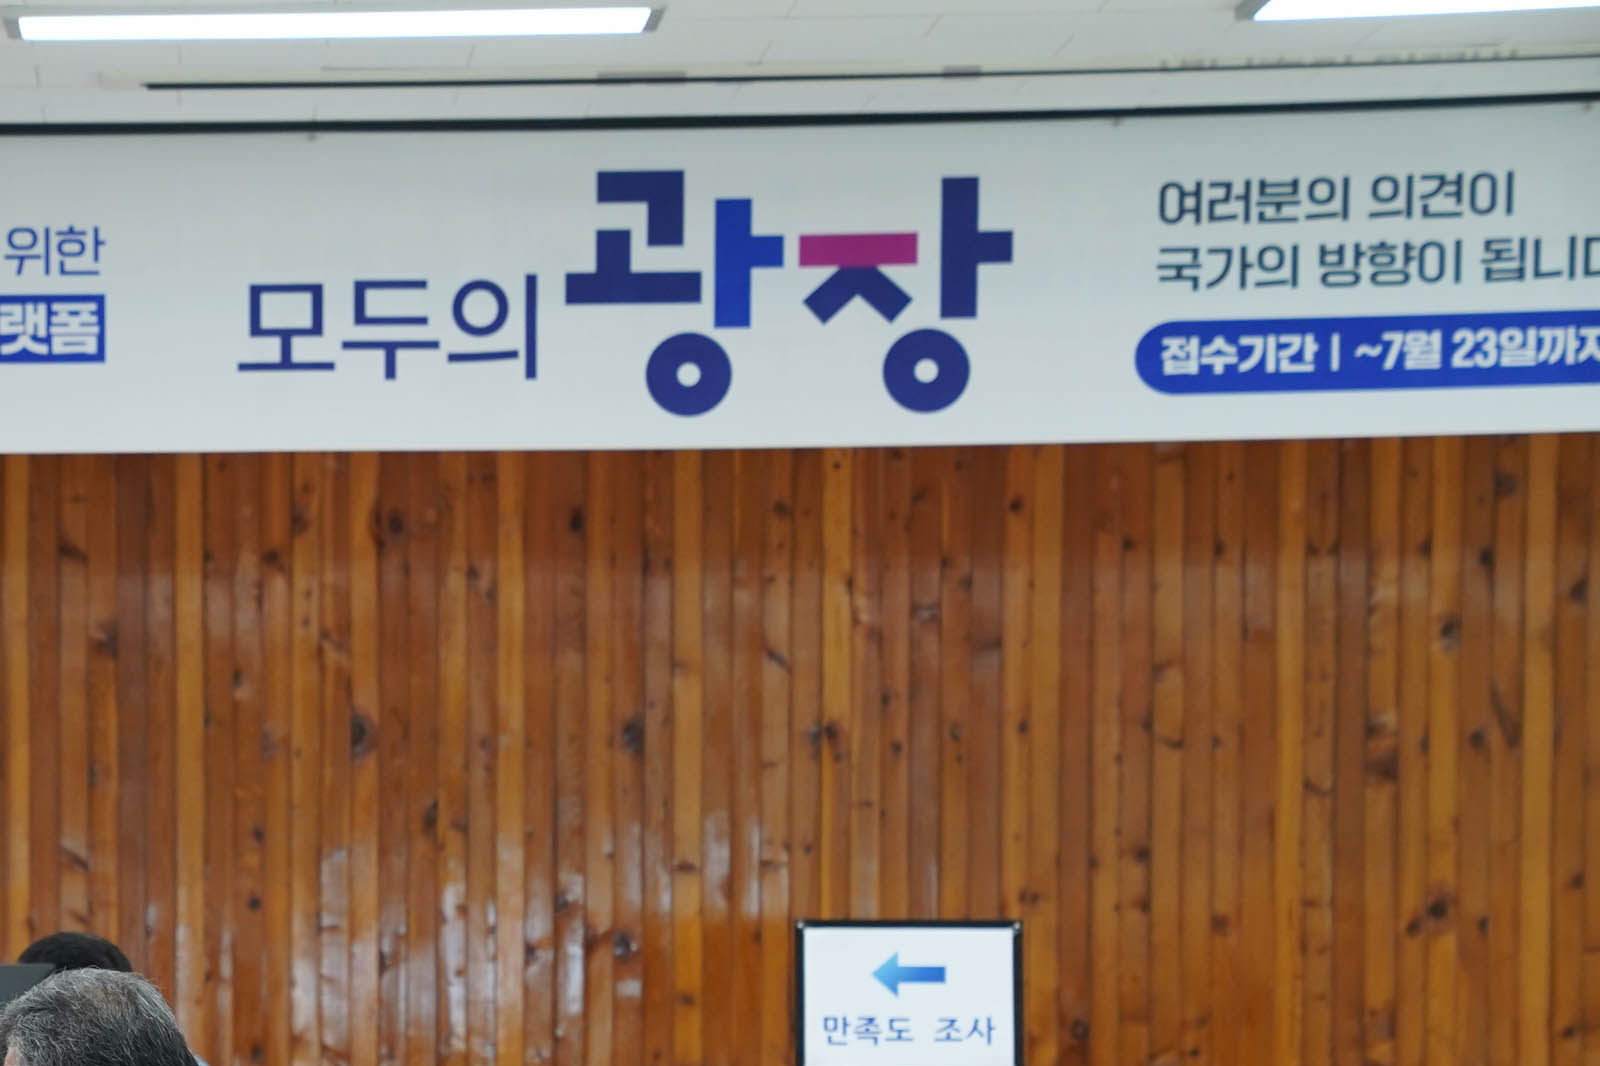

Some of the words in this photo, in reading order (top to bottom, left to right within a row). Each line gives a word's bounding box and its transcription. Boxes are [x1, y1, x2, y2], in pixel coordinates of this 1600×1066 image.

[1158, 174, 1351, 226] 여러분의
[1367, 169, 1515, 220] 의견이
[3, 224, 106, 277] 위한
[1156, 243, 1300, 293] 국가의
[1318, 238, 1463, 288] 방향이
[236, 273, 538, 381] 모두의
[564, 169, 1015, 417] 광장
[1160, 332, 1320, 377] 접수기간
[1354, 329, 1442, 371] ~7월
[822, 1015, 914, 1046] 만족도
[934, 1016, 996, 1046] 조사
